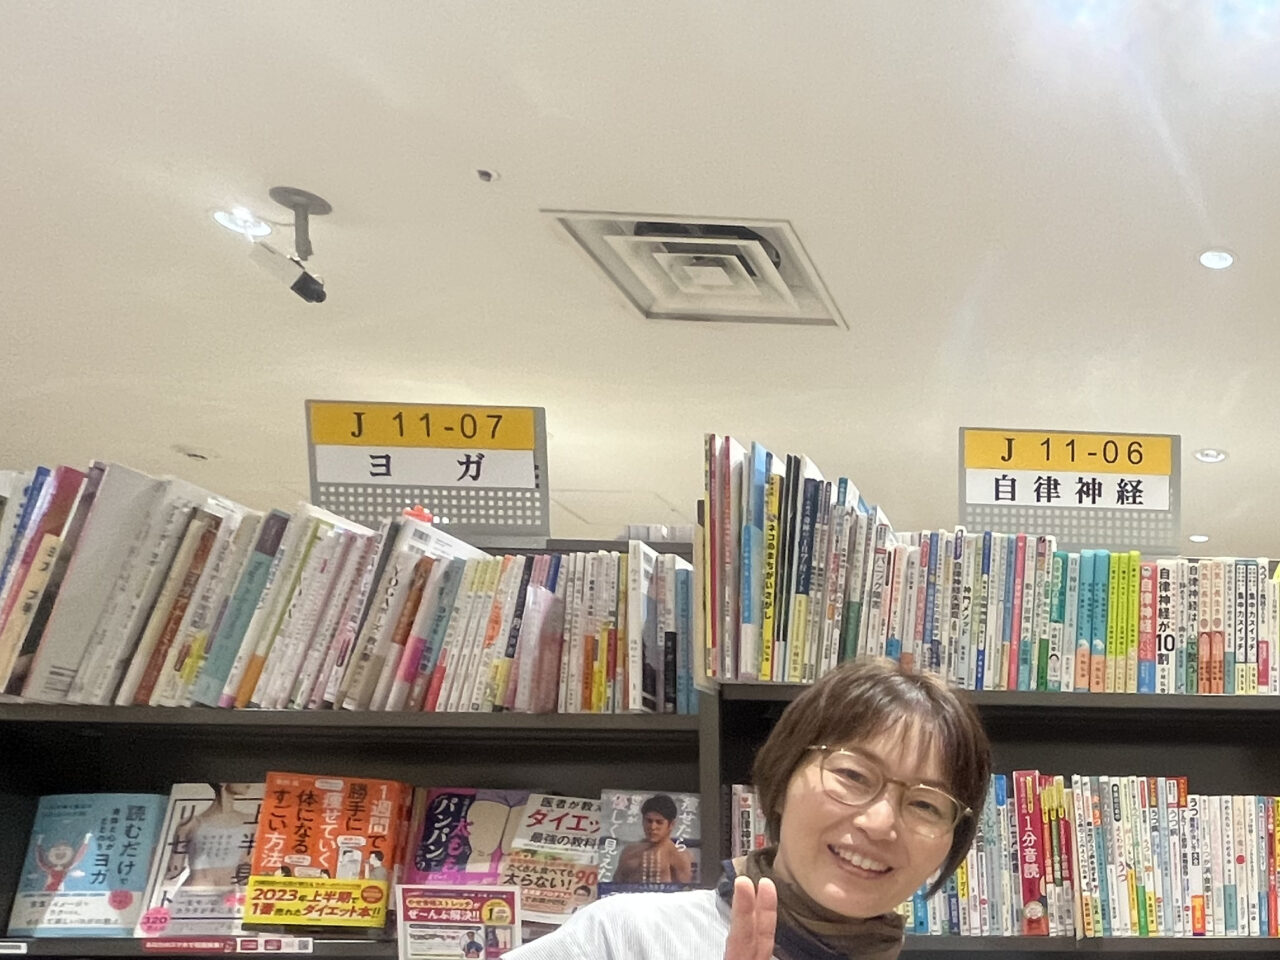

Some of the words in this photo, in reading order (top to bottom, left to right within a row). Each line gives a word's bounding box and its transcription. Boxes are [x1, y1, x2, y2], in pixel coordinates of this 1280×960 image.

[351, 412, 366, 438] J
[392, 411, 503, 439] 11-07
[1000, 437, 1016, 462] J
[1040, 437, 1144, 465] 11-06
[369, 453, 485, 482] ヨガ
[994, 474, 1144, 505] 自律神経
[1156, 567, 1175, 667] 自律神経が10割
[294, 789, 318, 854] 体になる
[368, 784, 392, 849] 1週間で
[117, 805, 146, 885] 読むだけで
[503, 874, 572, 891] 太らない!
